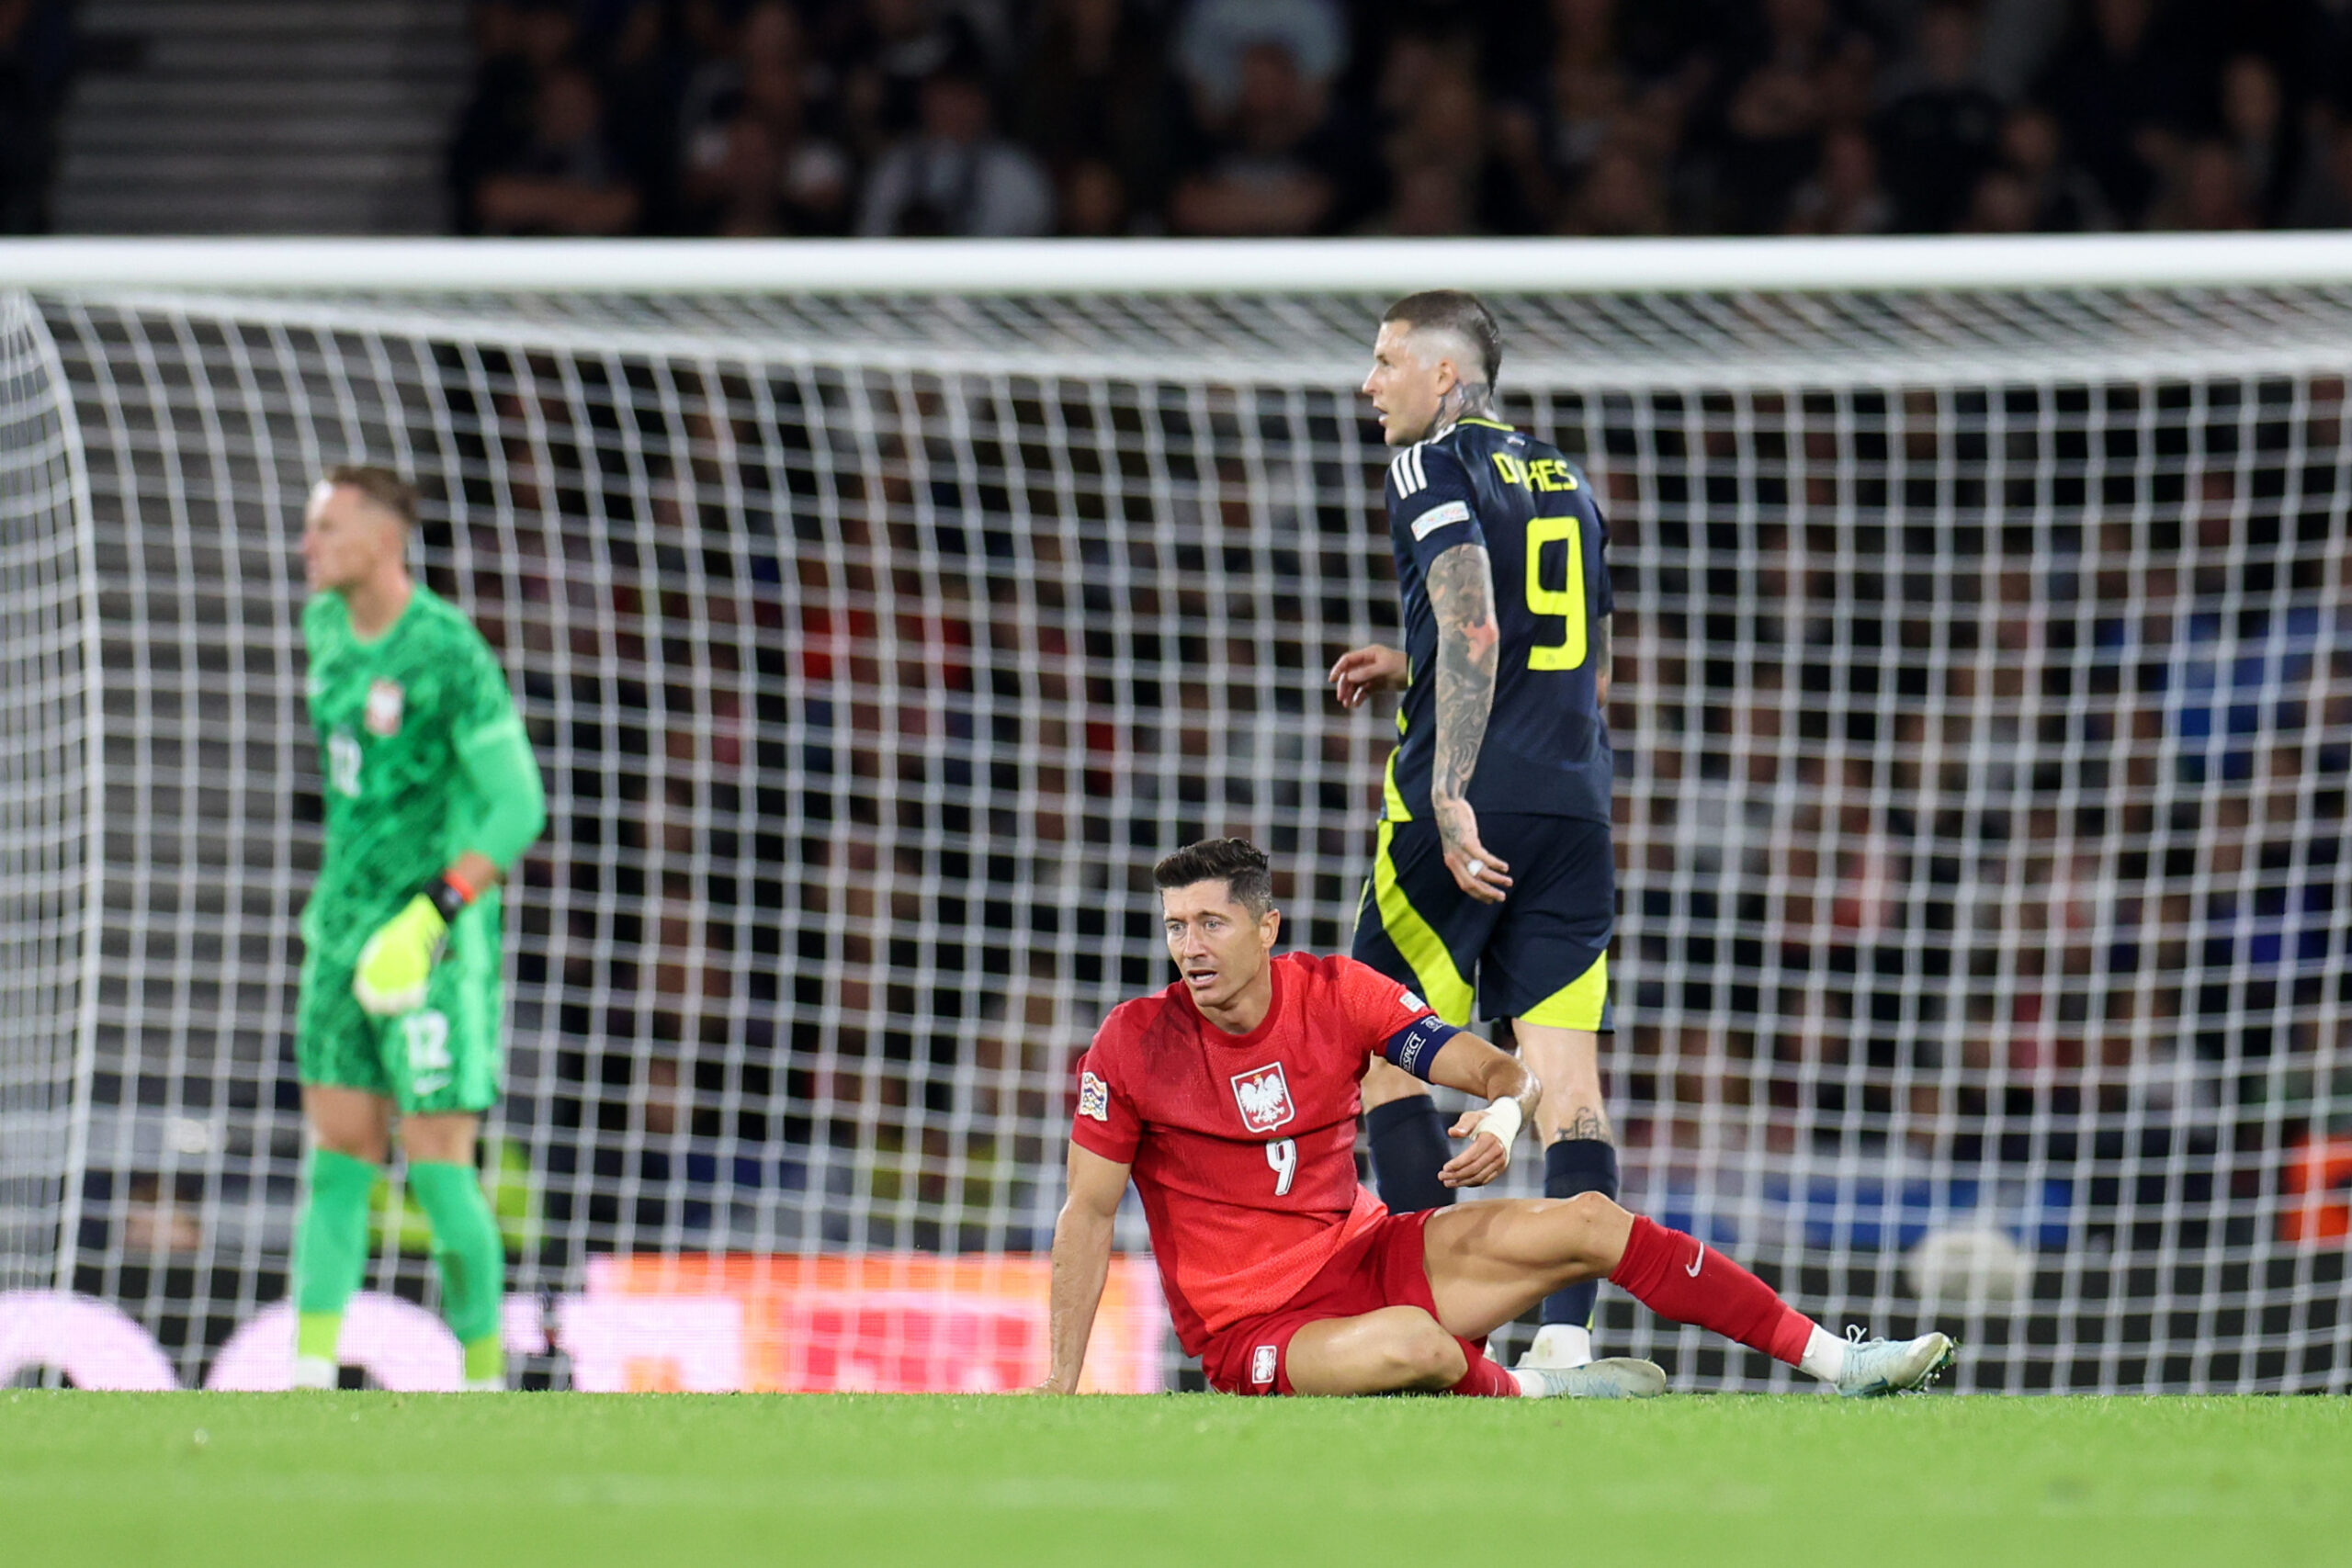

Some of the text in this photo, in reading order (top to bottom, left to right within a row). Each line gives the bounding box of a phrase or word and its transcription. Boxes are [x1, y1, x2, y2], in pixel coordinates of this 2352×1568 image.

[1492, 452, 1578, 491] DKES
[1526, 516, 1587, 671] 9
[403, 1010, 451, 1069] 12
[1403, 1032, 1421, 1071] ESPECT
[1265, 1136, 1296, 1197] 9
